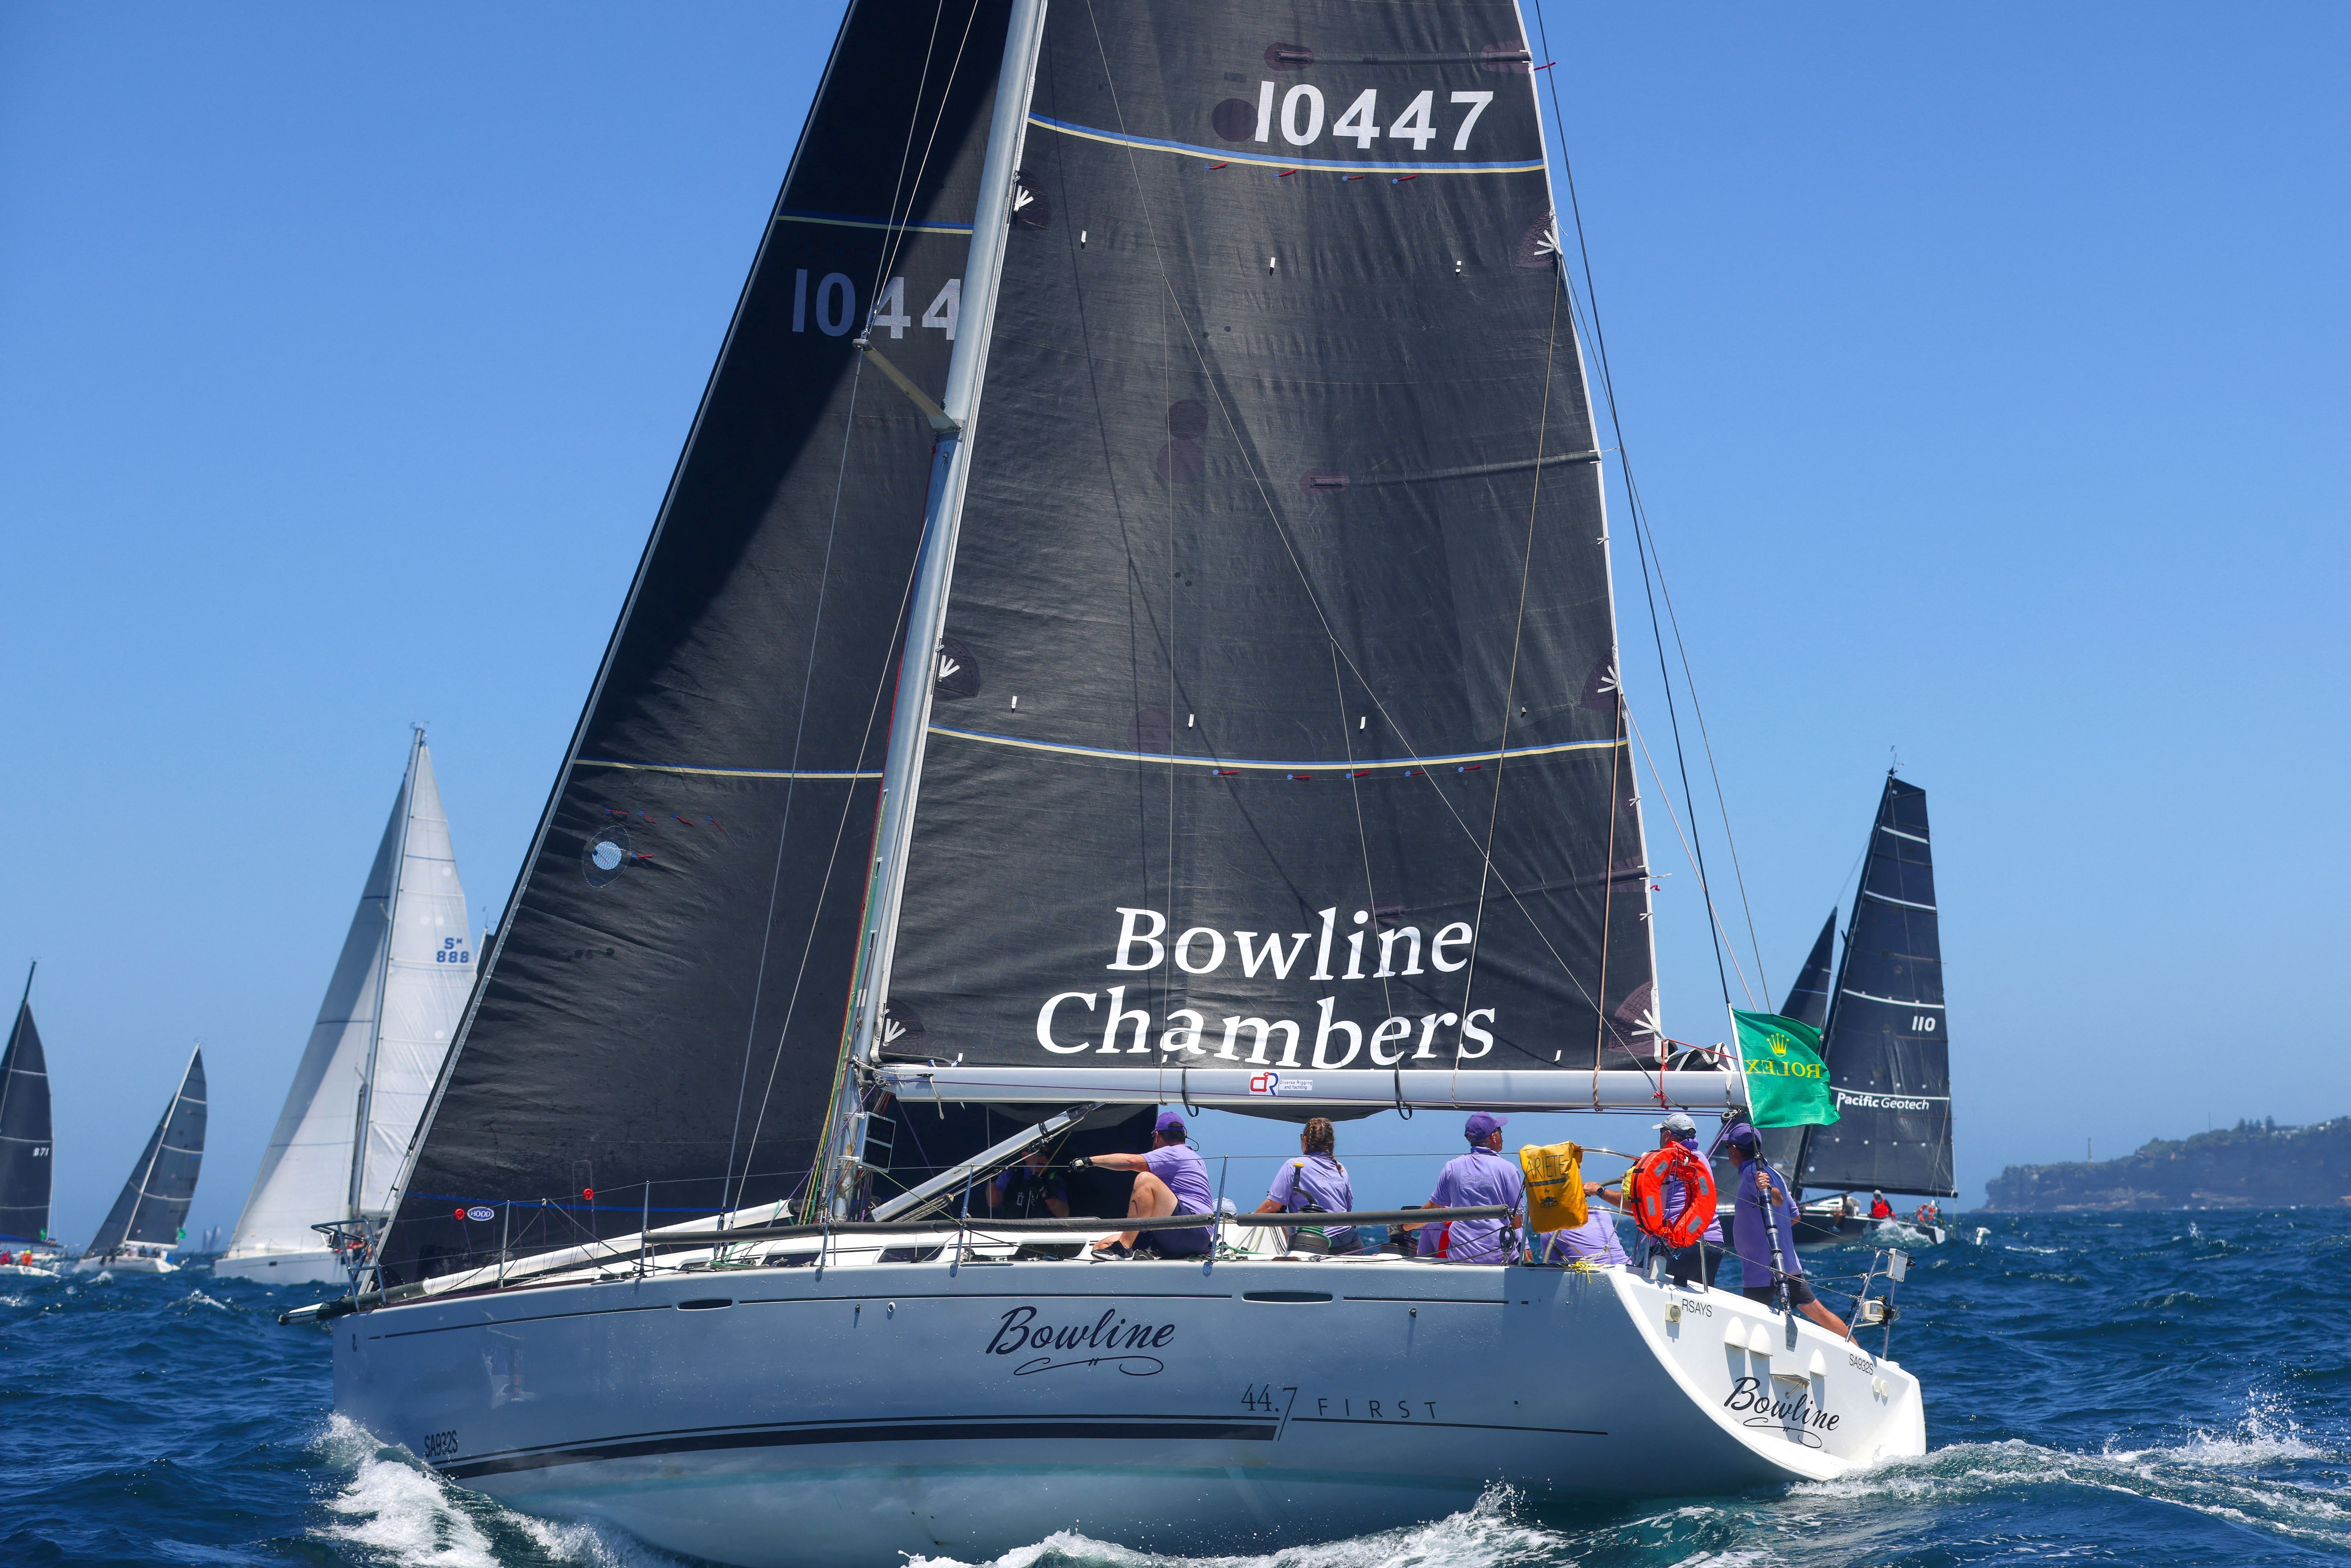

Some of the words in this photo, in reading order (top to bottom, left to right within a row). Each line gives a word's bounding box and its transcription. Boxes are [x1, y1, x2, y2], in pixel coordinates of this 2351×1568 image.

[1254, 81, 1494, 150] 10447
[436, 950, 469, 963] 888
[1106, 907, 1473, 980] Bowline
[1036, 985, 1496, 1069] Chambers
[1912, 1015, 1936, 1032] 110
[1836, 1092, 1880, 1112] Pacific
[1881, 1097, 1930, 1110] Geotech
[1526, 1154, 1565, 1179] ARIETE
[1682, 1298, 1712, 1317] RSAYS
[985, 1306, 1176, 1355] Bowline
[1849, 1353, 1874, 1375] SA932S
[1241, 1383, 1298, 1442] 44.7
[1318, 1398, 1437, 1419] FIRST
[1724, 1377, 1839, 1431] Bowline
[424, 1430, 458, 1458] SA932S
